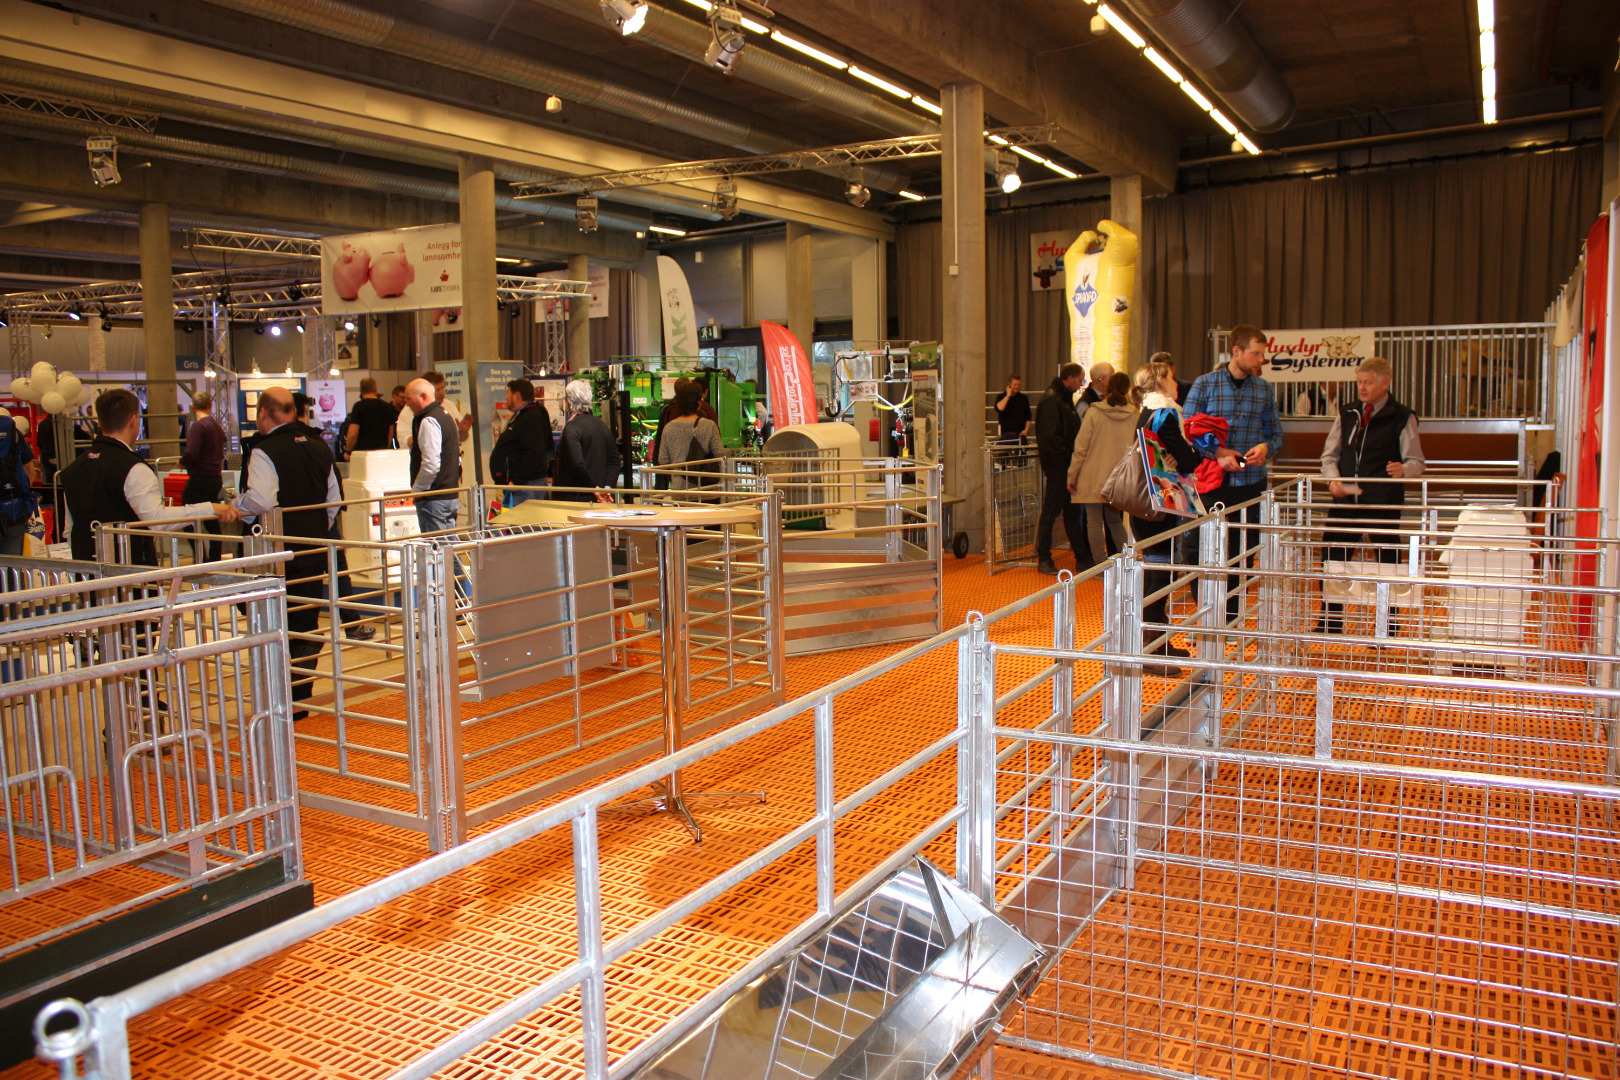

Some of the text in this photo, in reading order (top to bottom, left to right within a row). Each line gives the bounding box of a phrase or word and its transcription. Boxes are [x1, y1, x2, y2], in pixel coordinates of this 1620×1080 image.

[427, 240, 462, 251] Anlegg for
[183, 360, 199, 369] Gris
[1271, 350, 1364, 373] Systemer
